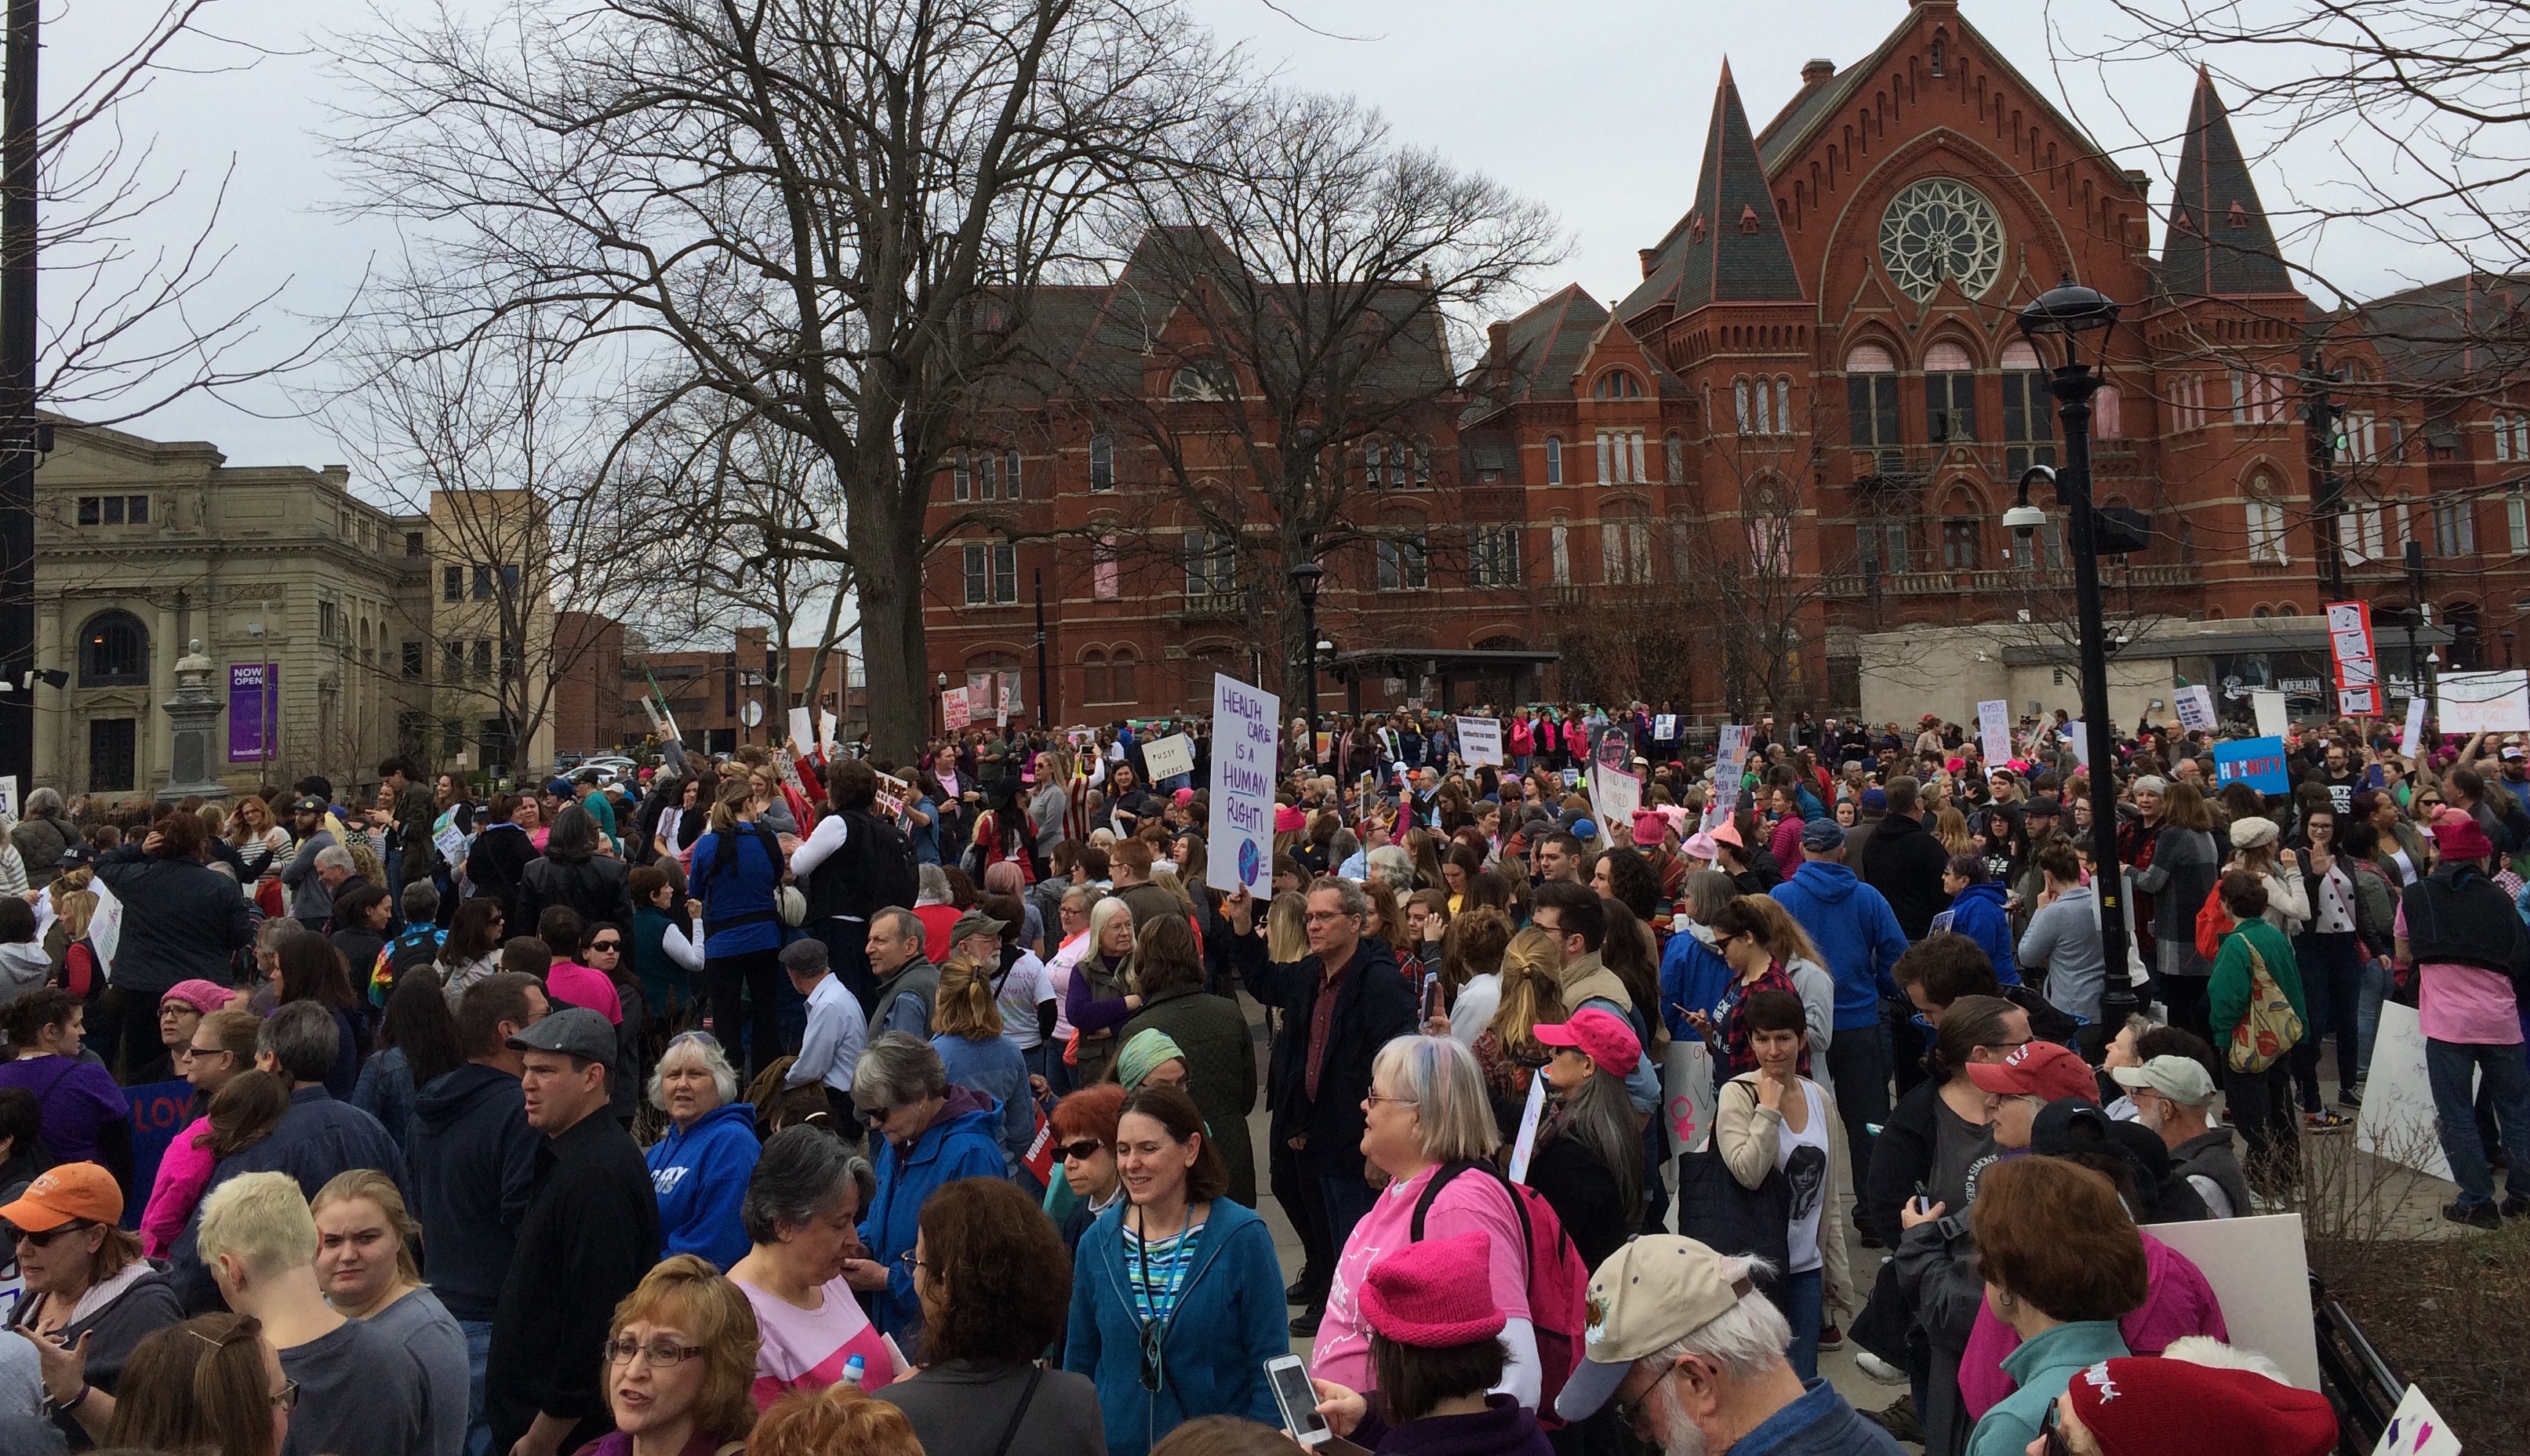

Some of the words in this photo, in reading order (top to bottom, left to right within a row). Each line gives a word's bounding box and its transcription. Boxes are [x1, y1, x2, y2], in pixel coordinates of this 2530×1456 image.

[234, 668, 263, 677] NOW
[234, 677, 263, 685] OPEN
[2277, 677, 2321, 692] MOERLEIN
[1222, 685, 1262, 722] HEALTH
[1247, 721, 1271, 744] CARE
[774, 752, 794, 763] THE
[1152, 748, 1176, 763] PUSSY
[1235, 741, 1245, 760] IS
[1248, 747, 1254, 764] A
[1156, 764, 1184, 779] UTERUS
[1223, 761, 1267, 797] HUMAN
[1621, 775, 1638, 793] WITH
[1227, 796, 1264, 841] RIGHT!
[133, 1094, 194, 1133] LOV
[1968, 1153, 1999, 1176] SIMON'S
[1965, 1182, 1977, 1205] GREA
